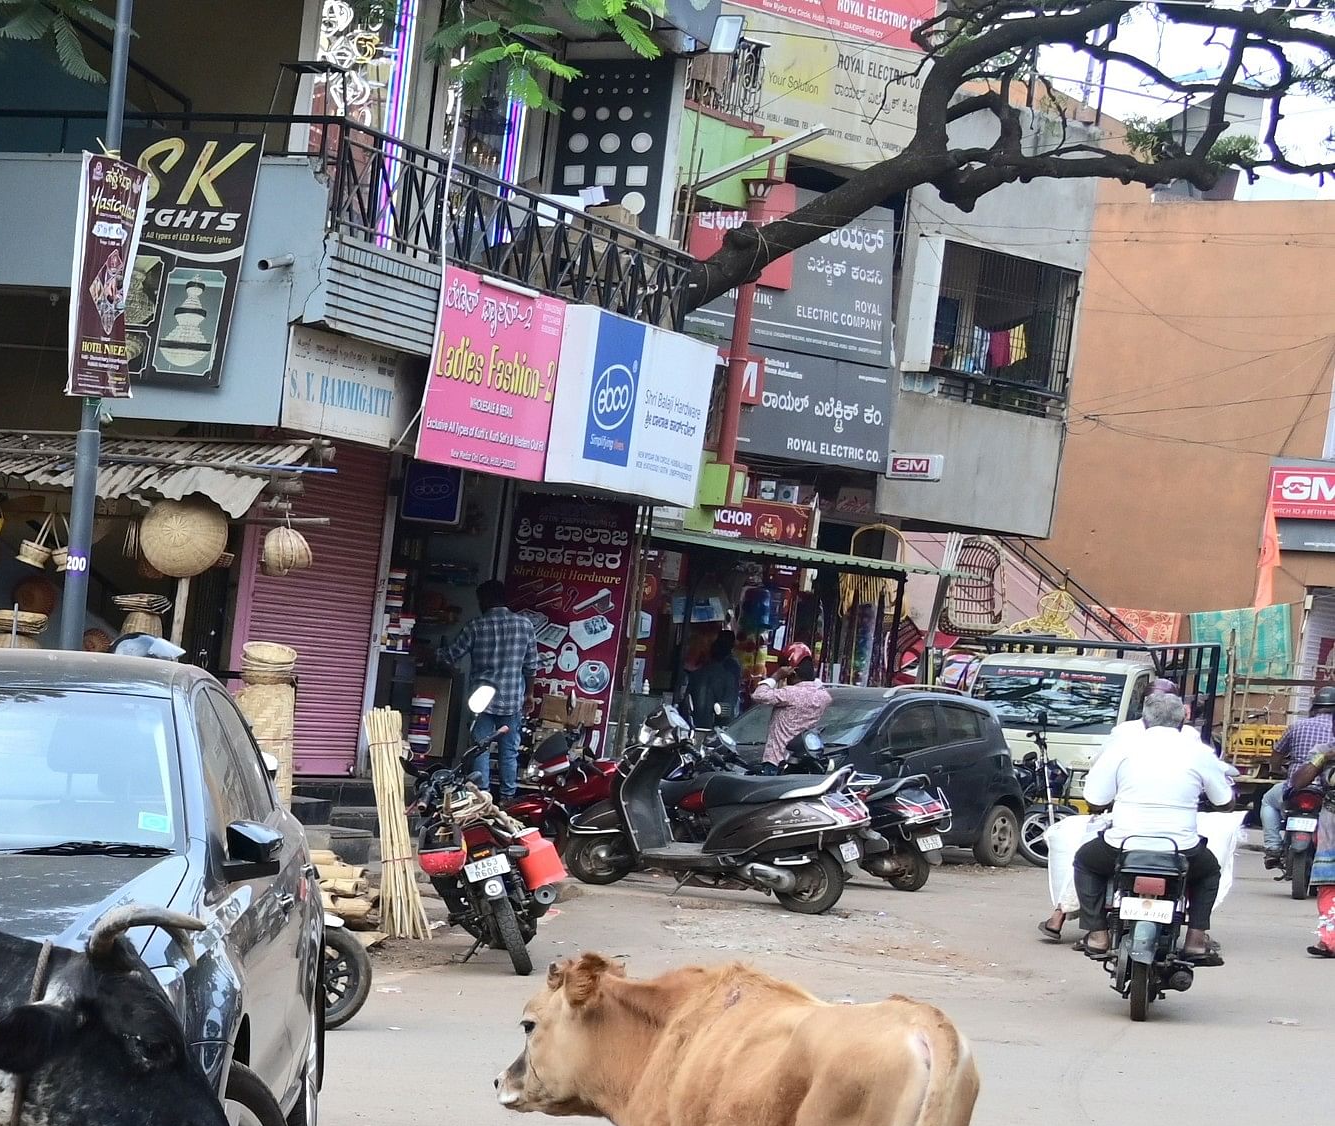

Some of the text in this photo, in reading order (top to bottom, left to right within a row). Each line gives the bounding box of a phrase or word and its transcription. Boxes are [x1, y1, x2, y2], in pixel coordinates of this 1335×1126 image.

[837, 0, 865, 17] ROYAL
[867, 7, 908, 30] ELECTRIC
[837, 53, 864, 74] ROYAL
[868, 62, 908, 86] ELECTRIC
[768, 71, 819, 95] Your Solution
[137, 137, 257, 207] SK
[141, 207, 242, 231] IGHTS
[179, 233, 190, 241] LED
[196, 233, 213, 245] Fancy
[214, 235, 231, 245] Lights
[796, 305, 882, 332] ELECTRIC COMPANY
[854, 299, 882, 316] ROYAL
[81, 341, 102, 354] HOTEL
[435, 330, 485, 386] Ladies
[486, 344, 556, 404] Fashion-2
[597, 369, 629, 415] ebco
[761, 391, 810, 413] ರಾಯಲ್
[645, 389, 701, 420] Shri Balaji Hardware
[589, 433, 614, 451] Simplifying
[787, 437, 881, 464] ROYAL ELECTRIC CO.
[896, 459, 928, 471] GM
[714, 508, 752, 526] NCHOR
[515, 518, 544, 544] ಶ್ರೀ
[513, 564, 621, 585] Shri Balaji Hardware
